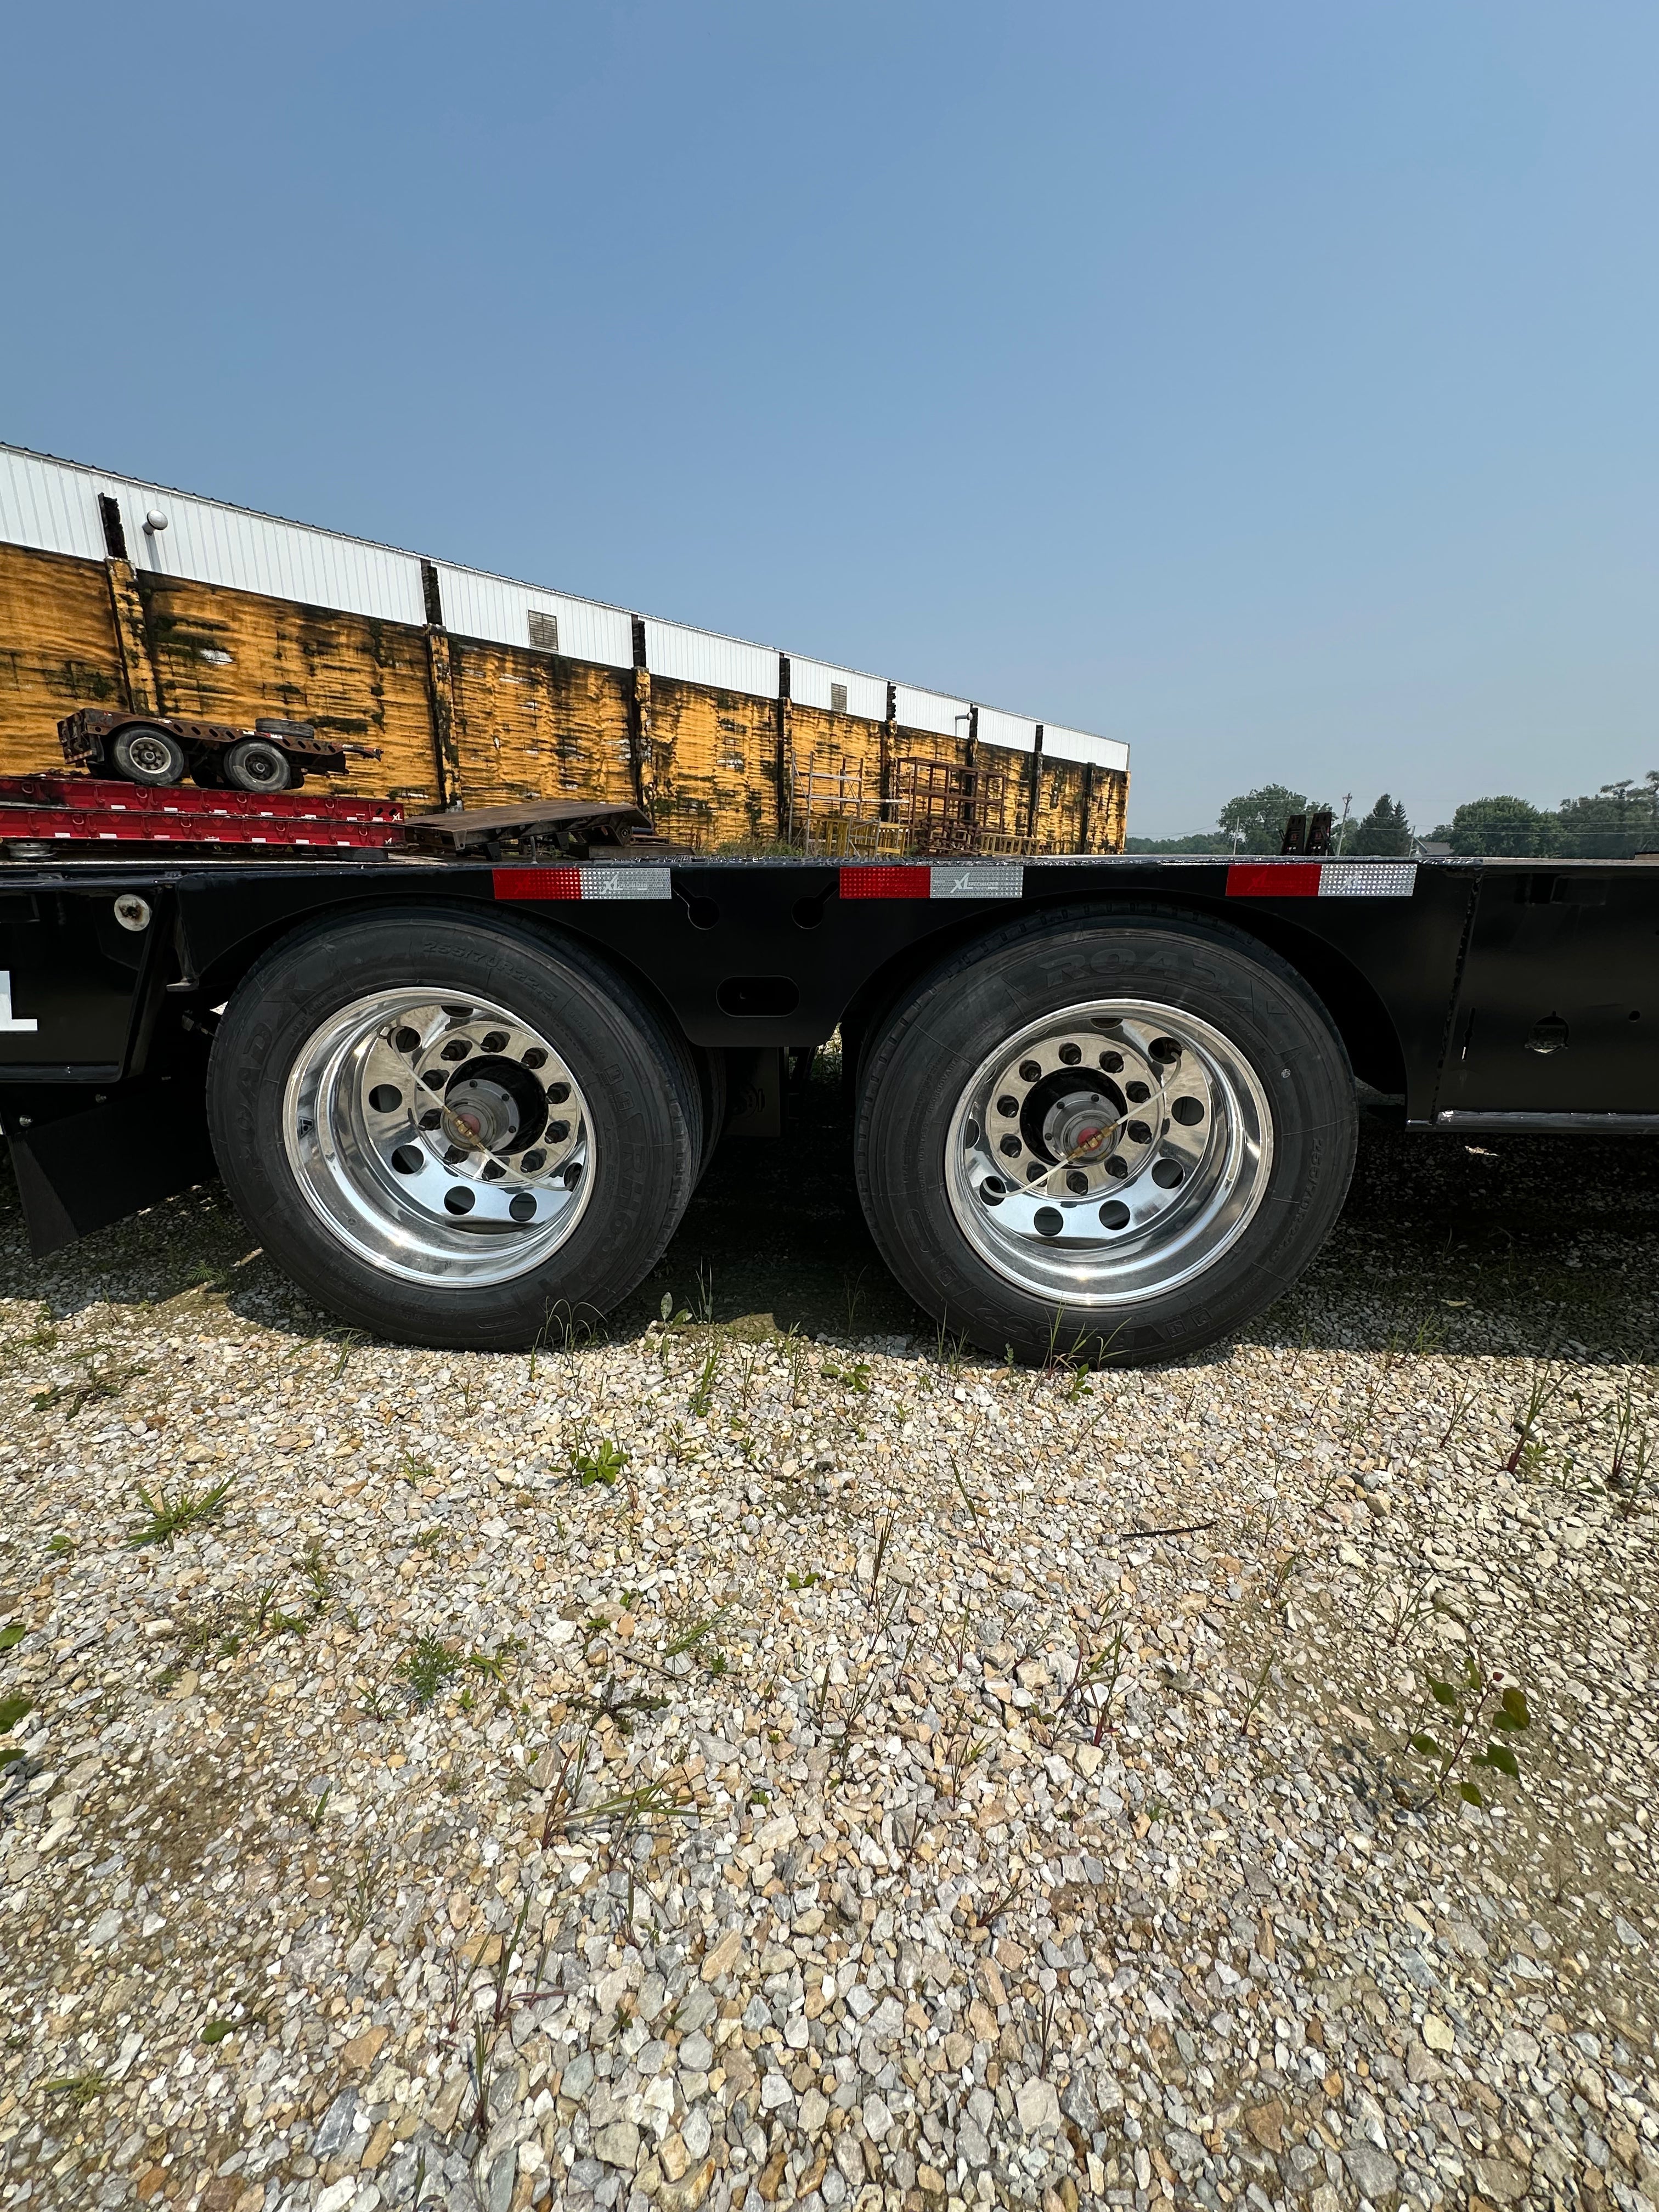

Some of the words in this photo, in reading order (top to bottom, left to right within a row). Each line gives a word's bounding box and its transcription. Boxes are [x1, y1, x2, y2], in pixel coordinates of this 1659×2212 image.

[392, 812, 403, 822] XL
[950, 872, 974, 893] XL
[422, 941, 559, 1004] 255/70R22.5
[1040, 948, 1288, 1025] ROADX
[579, 1142, 646, 1286] RH652
[1266, 1137, 1323, 1265] 255/70R22.5
